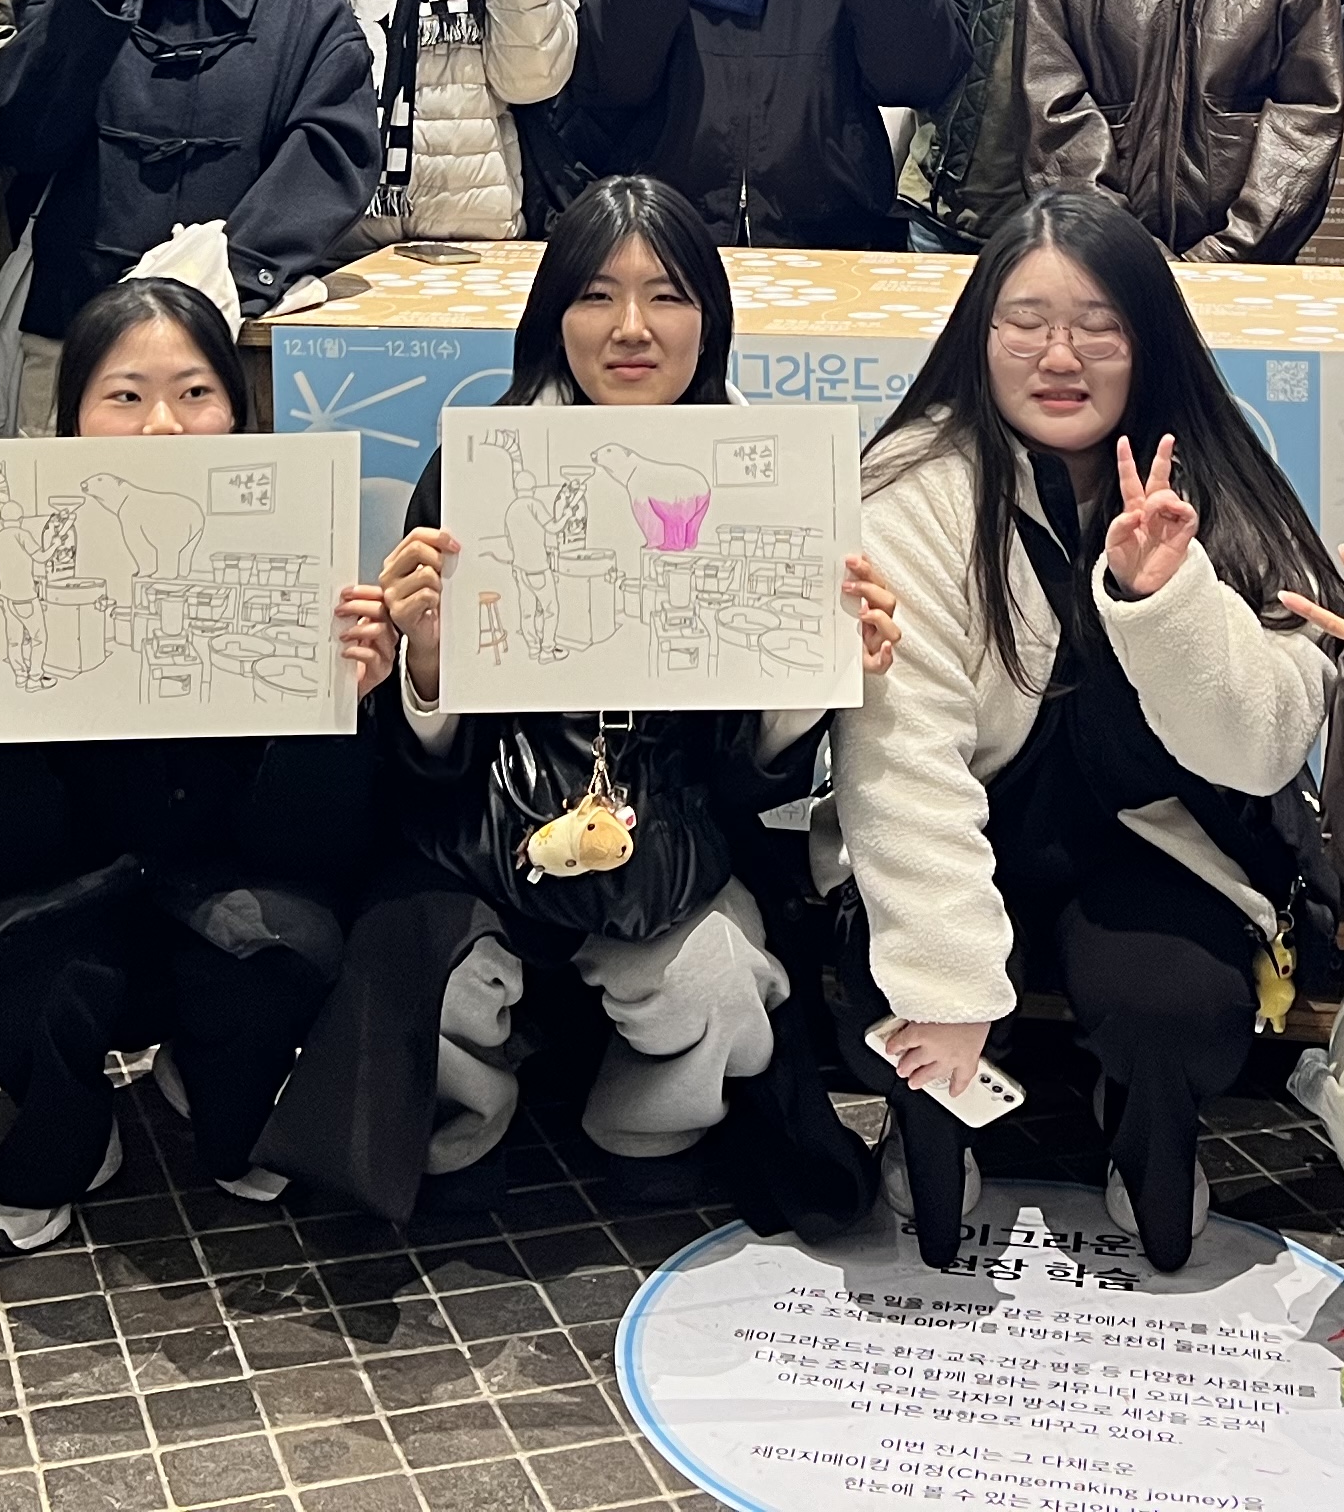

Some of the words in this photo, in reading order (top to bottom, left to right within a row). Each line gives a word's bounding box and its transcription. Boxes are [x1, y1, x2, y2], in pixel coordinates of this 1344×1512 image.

[900, 1218, 1146, 1257] 이그라운
[940, 1254, 1029, 1280] 현장
[1045, 1261, 1140, 1291] 학습
[773, 1301, 815, 1316] 이웃
[822, 1306, 906, 1325] 조직들의
[914, 1316, 999, 1334] 이야기를
[1007, 1325, 1094, 1344] 탐방하듯
[1102, 1333, 1165, 1351] 천천히
[1175, 1339, 1291, 1363] 둘러보세요.
[834, 1290, 875, 1304] 다른
[883, 1295, 923, 1310] 일을
[932, 1301, 994, 1316] 하지만
[1002, 1306, 1045, 1321] 같은
[1053, 1311, 1136, 1329] 공간에서
[1145, 1319, 1208, 1335] 하루를
[1216, 1327, 1282, 1344] 보내는
[755, 1349, 819, 1368] 다루는
[826, 1358, 914, 1379] 조직들이
[923, 1367, 966, 1384] 함께
[974, 1372, 1041, 1389] 일하는
[1047, 1379, 1136, 1400] 커뮤니티
[1146, 1388, 1289, 1415] 오피스입니다.
[777, 1372, 864, 1393] 이곳에서
[873, 1381, 940, 1401] 우리는
[947, 1388, 1014, 1407] 각자의
[1023, 1395, 1114, 1416] 방식으로
[1121, 1406, 1190, 1426] 세상을
[1198, 1414, 1266, 1434] 조금씩
[1130, 1369, 1196, 1386] 다양한
[1204, 1375, 1316, 1398] 사회문제를
[850, 1400, 871, 1413] 더
[880, 1402, 924, 1418] 나은
[932, 1407, 1022, 1427] 방향으로
[1031, 1417, 1099, 1436] 바꾸고
[1108, 1424, 1183, 1445] 있어요.
[880, 1438, 925, 1454] 이번
[934, 1442, 1004, 1461] 전시는
[1010, 1451, 1033, 1464] 그
[1042, 1454, 1136, 1476] 다채로운
[844, 1476, 913, 1497] 한눈에
[954, 1489, 977, 1502] 수
[985, 1490, 1032, 1508] 있는
